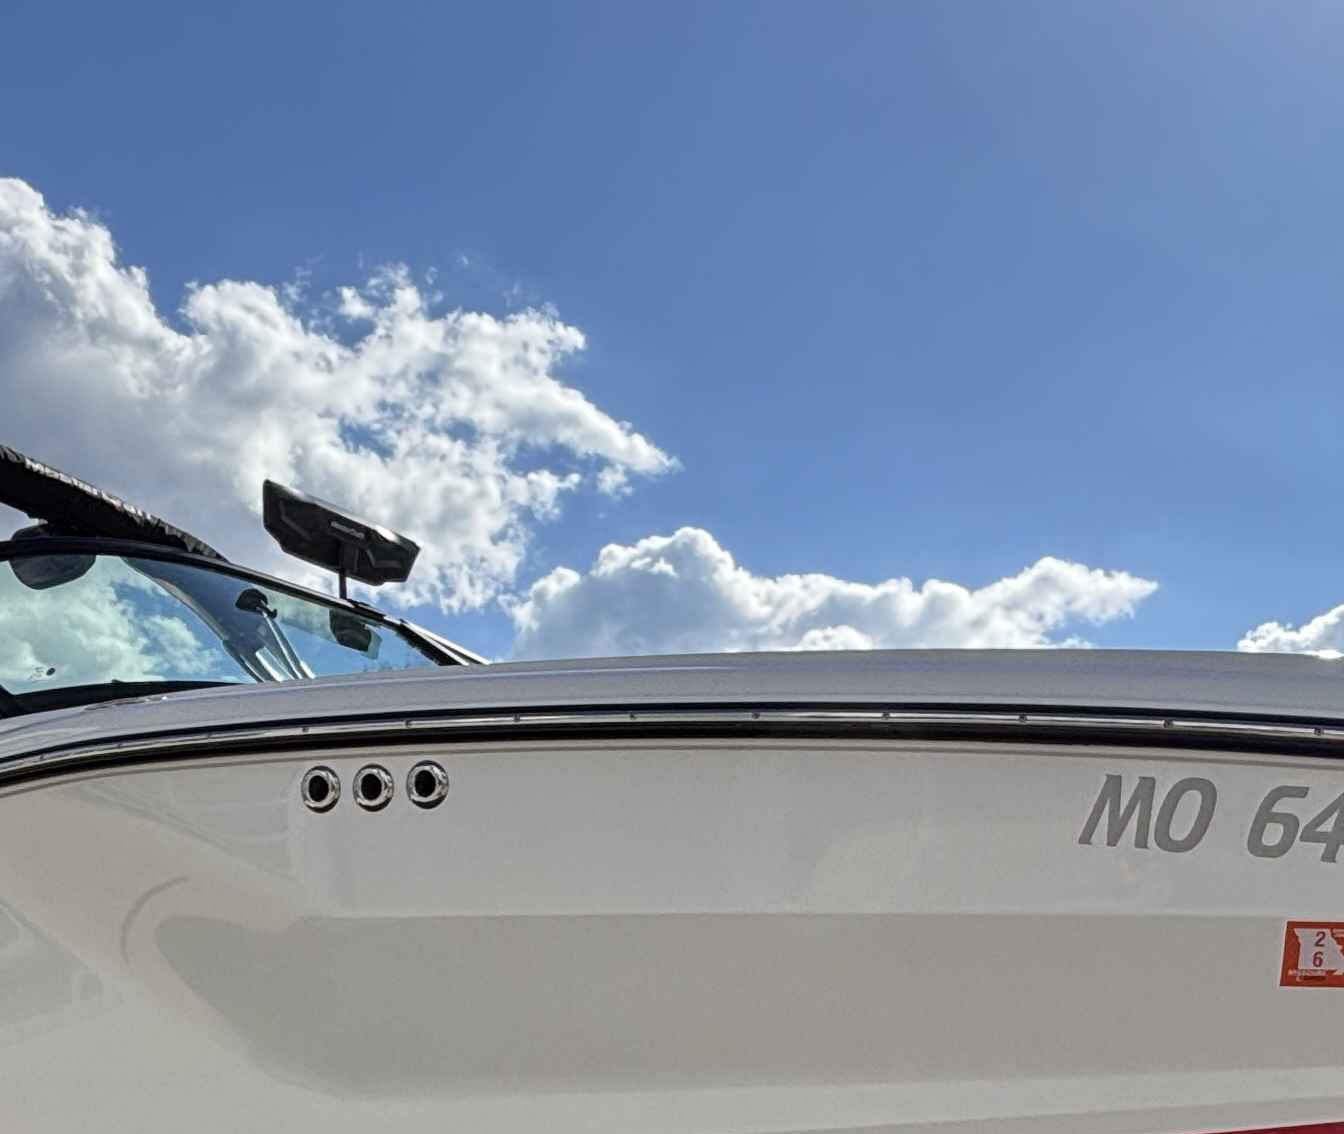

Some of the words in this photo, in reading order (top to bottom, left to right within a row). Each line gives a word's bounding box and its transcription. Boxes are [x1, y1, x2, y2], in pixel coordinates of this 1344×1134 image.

[1078, 774, 1217, 853] MO
[1314, 931, 1326, 947] 2
[1313, 951, 1324, 967] 6
